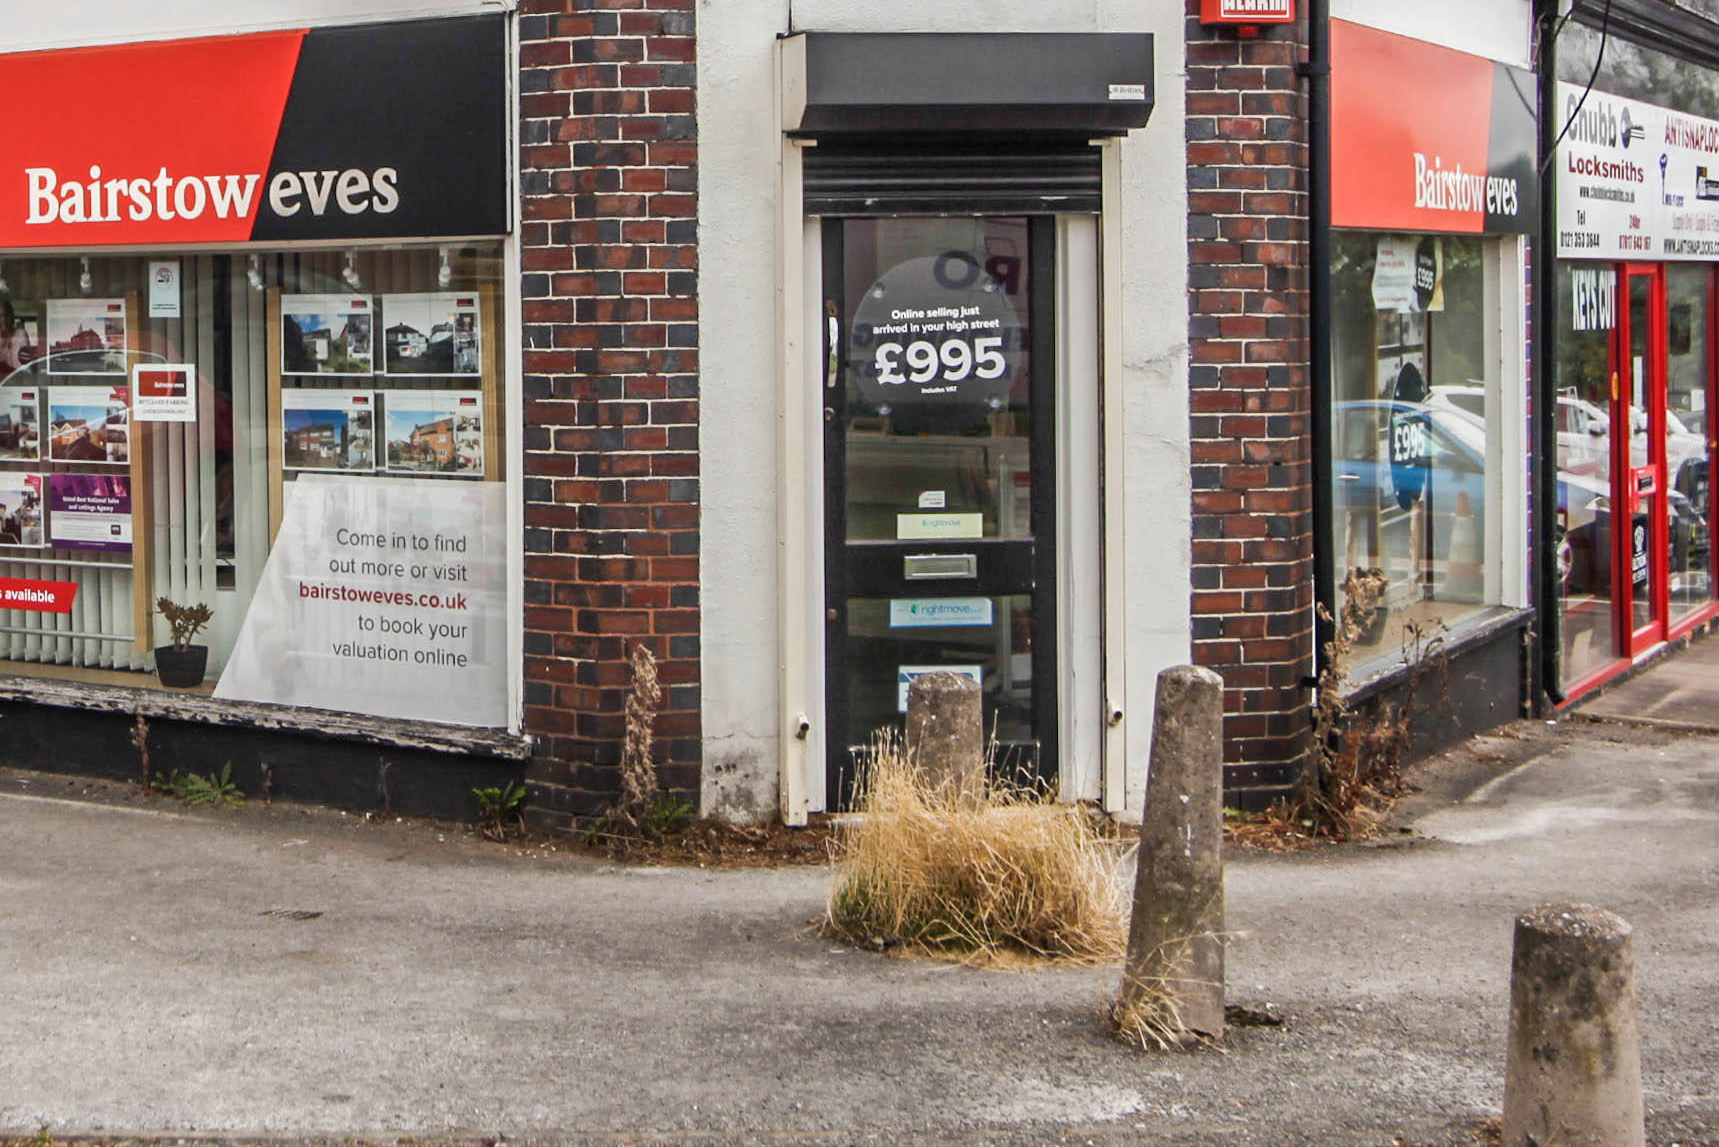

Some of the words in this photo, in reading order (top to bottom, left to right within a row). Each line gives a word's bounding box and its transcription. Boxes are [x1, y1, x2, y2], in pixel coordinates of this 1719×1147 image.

[1567, 93, 1618, 149] Chubb
[1568, 151, 1644, 183] Locksmiths
[25, 164, 261, 224] Bairstow
[268, 167, 400, 218] eves
[1414, 152, 1485, 212] Bairstow
[1486, 175, 1518, 216] eves
[1576, 209, 1586, 226] Tel
[1560, 230, 1574, 248] 0121
[891, 309, 925, 320] Online
[926, 307, 960, 319] selling
[960, 305, 980, 318] just
[1572, 269, 1598, 331] KEYS
[1598, 269, 1616, 330] CUT
[872, 322, 908, 335] arrived
[910, 323, 920, 333] in
[921, 324, 945, 334] your
[946, 320, 969, 333] high
[970, 318, 1000, 329] street
[874, 336, 1007, 385] £995
[1394, 421, 1426, 462] £995
[336, 528, 386, 548] Come
[391, 532, 406, 549] in
[412, 535, 429, 551] to
[434, 534, 467, 553] find
[329, 558, 356, 574] out
[361, 562, 405, 577] more
[410, 565, 428, 579] or
[433, 564, 468, 582] visit
[4, 587, 55, 603] available
[299, 581, 468, 610] bairstoweves.co.uk
[358, 614, 374, 631] to
[380, 615, 423, 635] book
[429, 622, 468, 640] your
[332, 641, 408, 662] valuation
[414, 648, 468, 668] online
